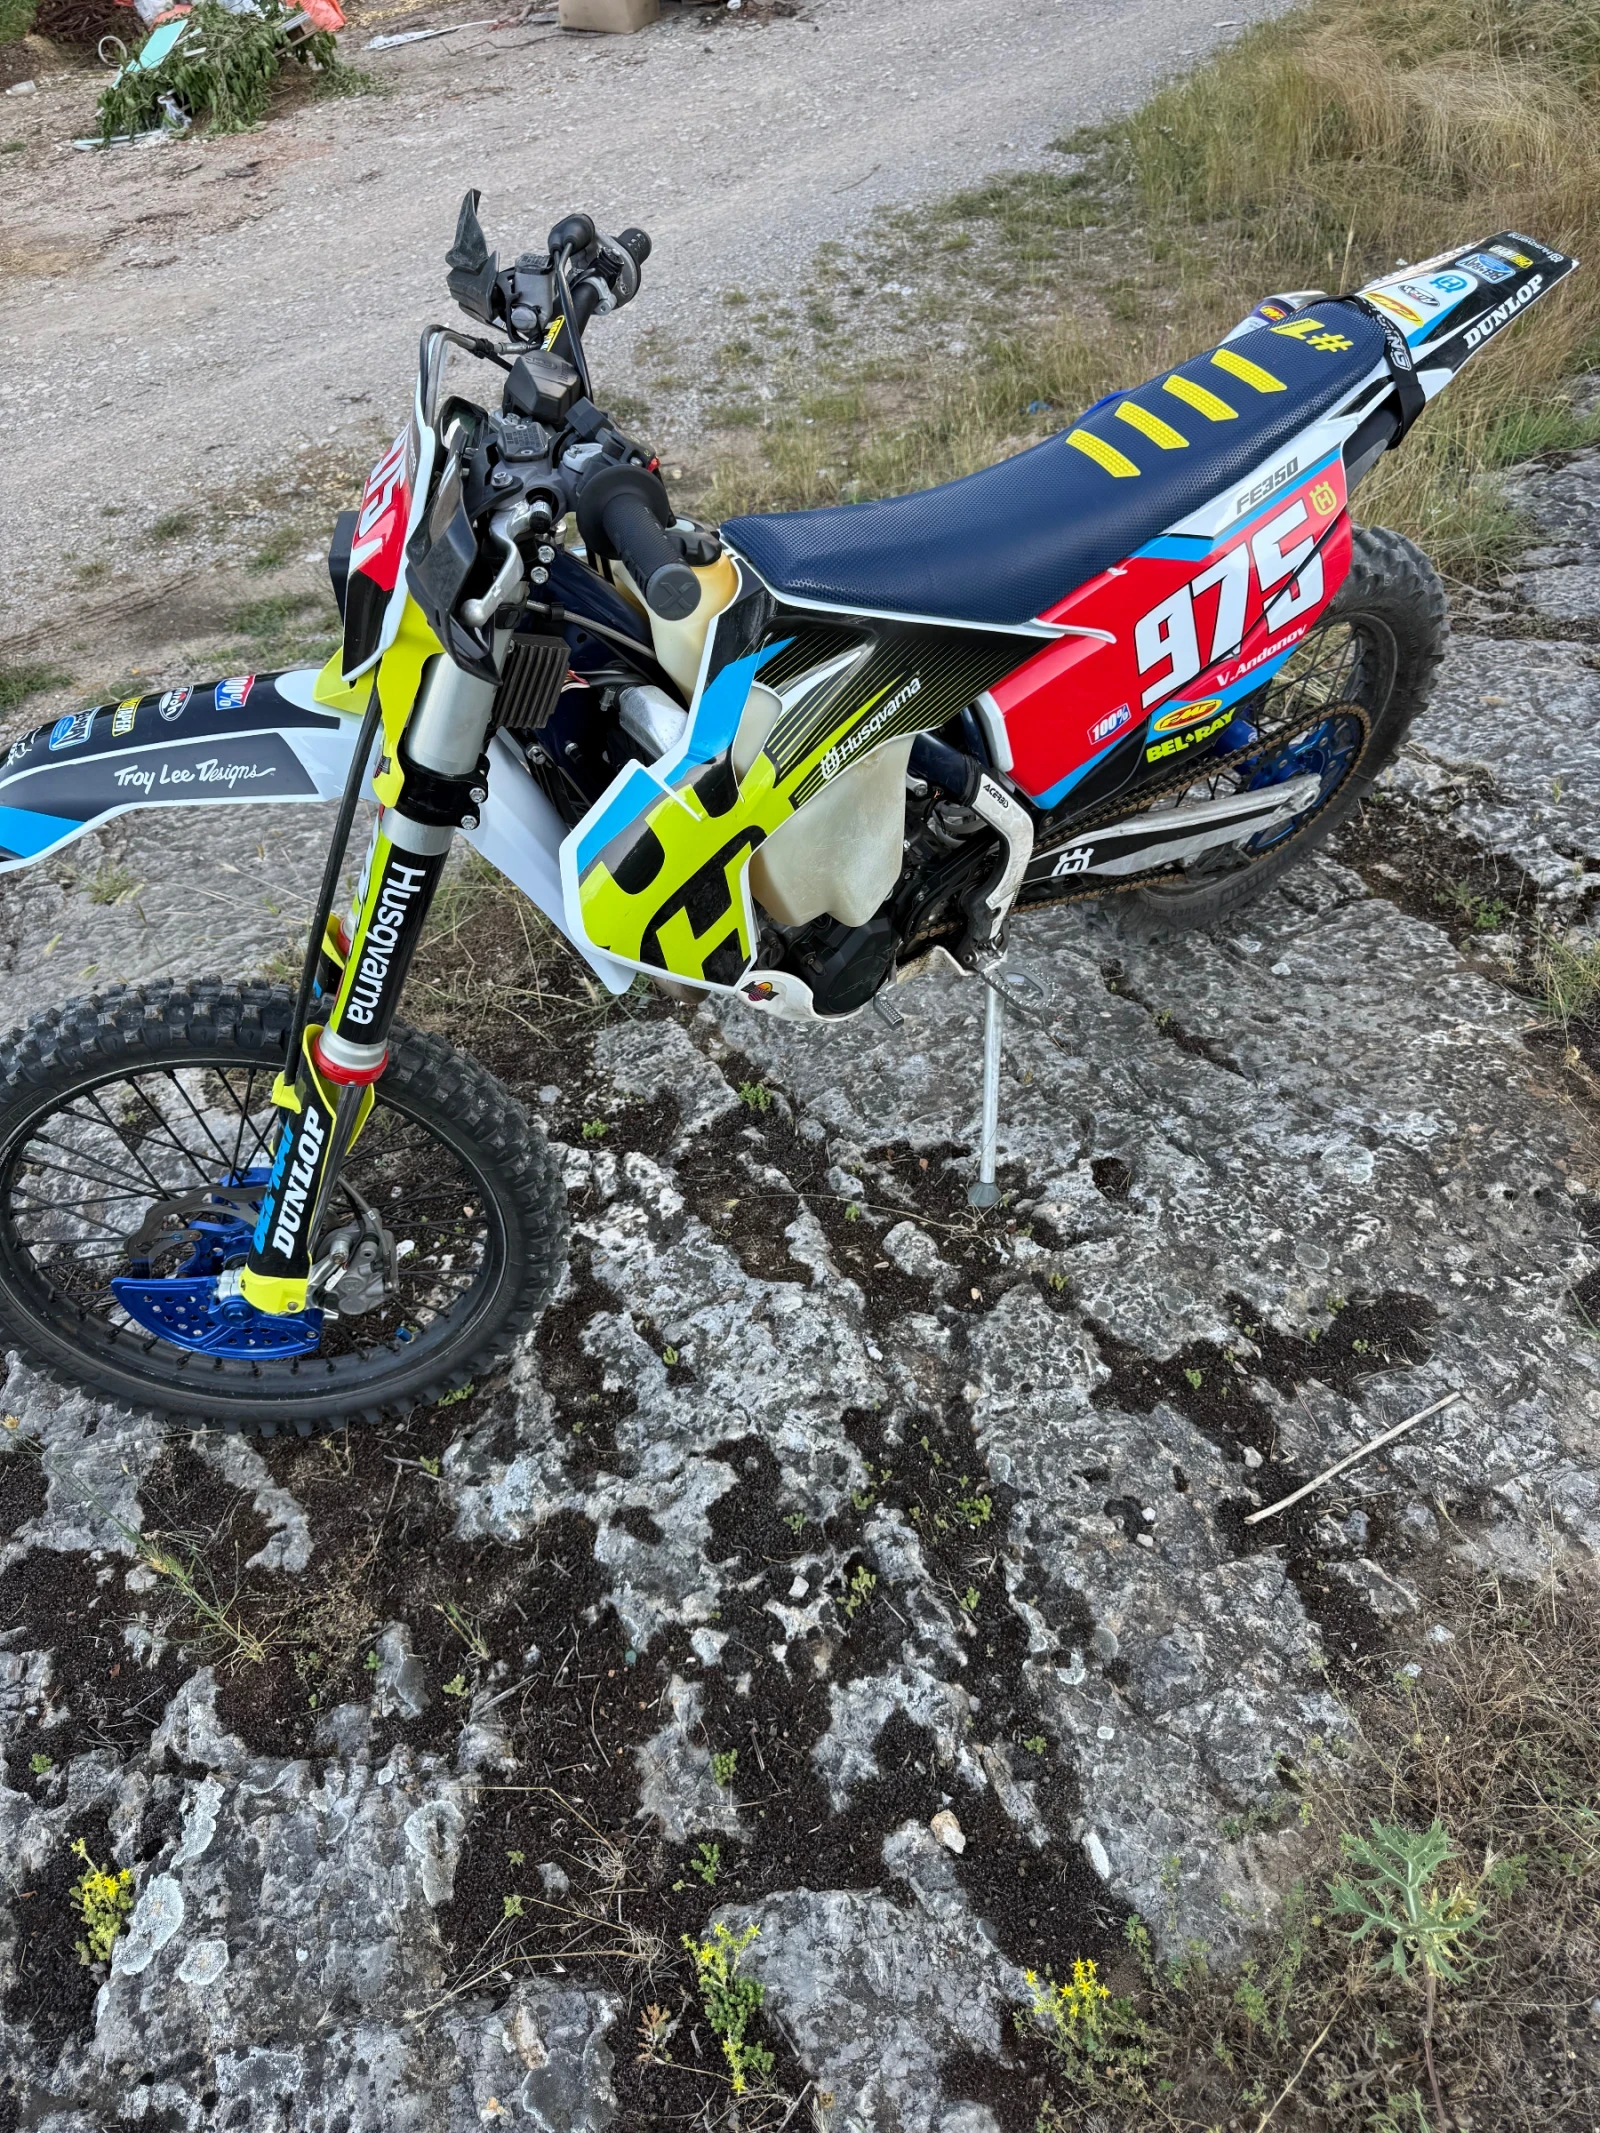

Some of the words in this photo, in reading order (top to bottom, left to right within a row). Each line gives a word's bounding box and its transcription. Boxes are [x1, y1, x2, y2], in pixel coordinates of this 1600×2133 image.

[1463, 274, 1543, 349] DUNLOP
[1236, 457, 1299, 515] FE350
[1133, 497, 1326, 711] 975
[218, 676, 251, 708] 00%
[840, 674, 922, 762] Husqvarna
[1091, 706, 1130, 741] 100%
[114, 765, 156, 794] Troy
[159, 764, 195, 784] Lee
[196, 758, 276, 789] Designs
[346, 861, 426, 1026] Husqvarna
[272, 1107, 320, 1259] DUNLOP
